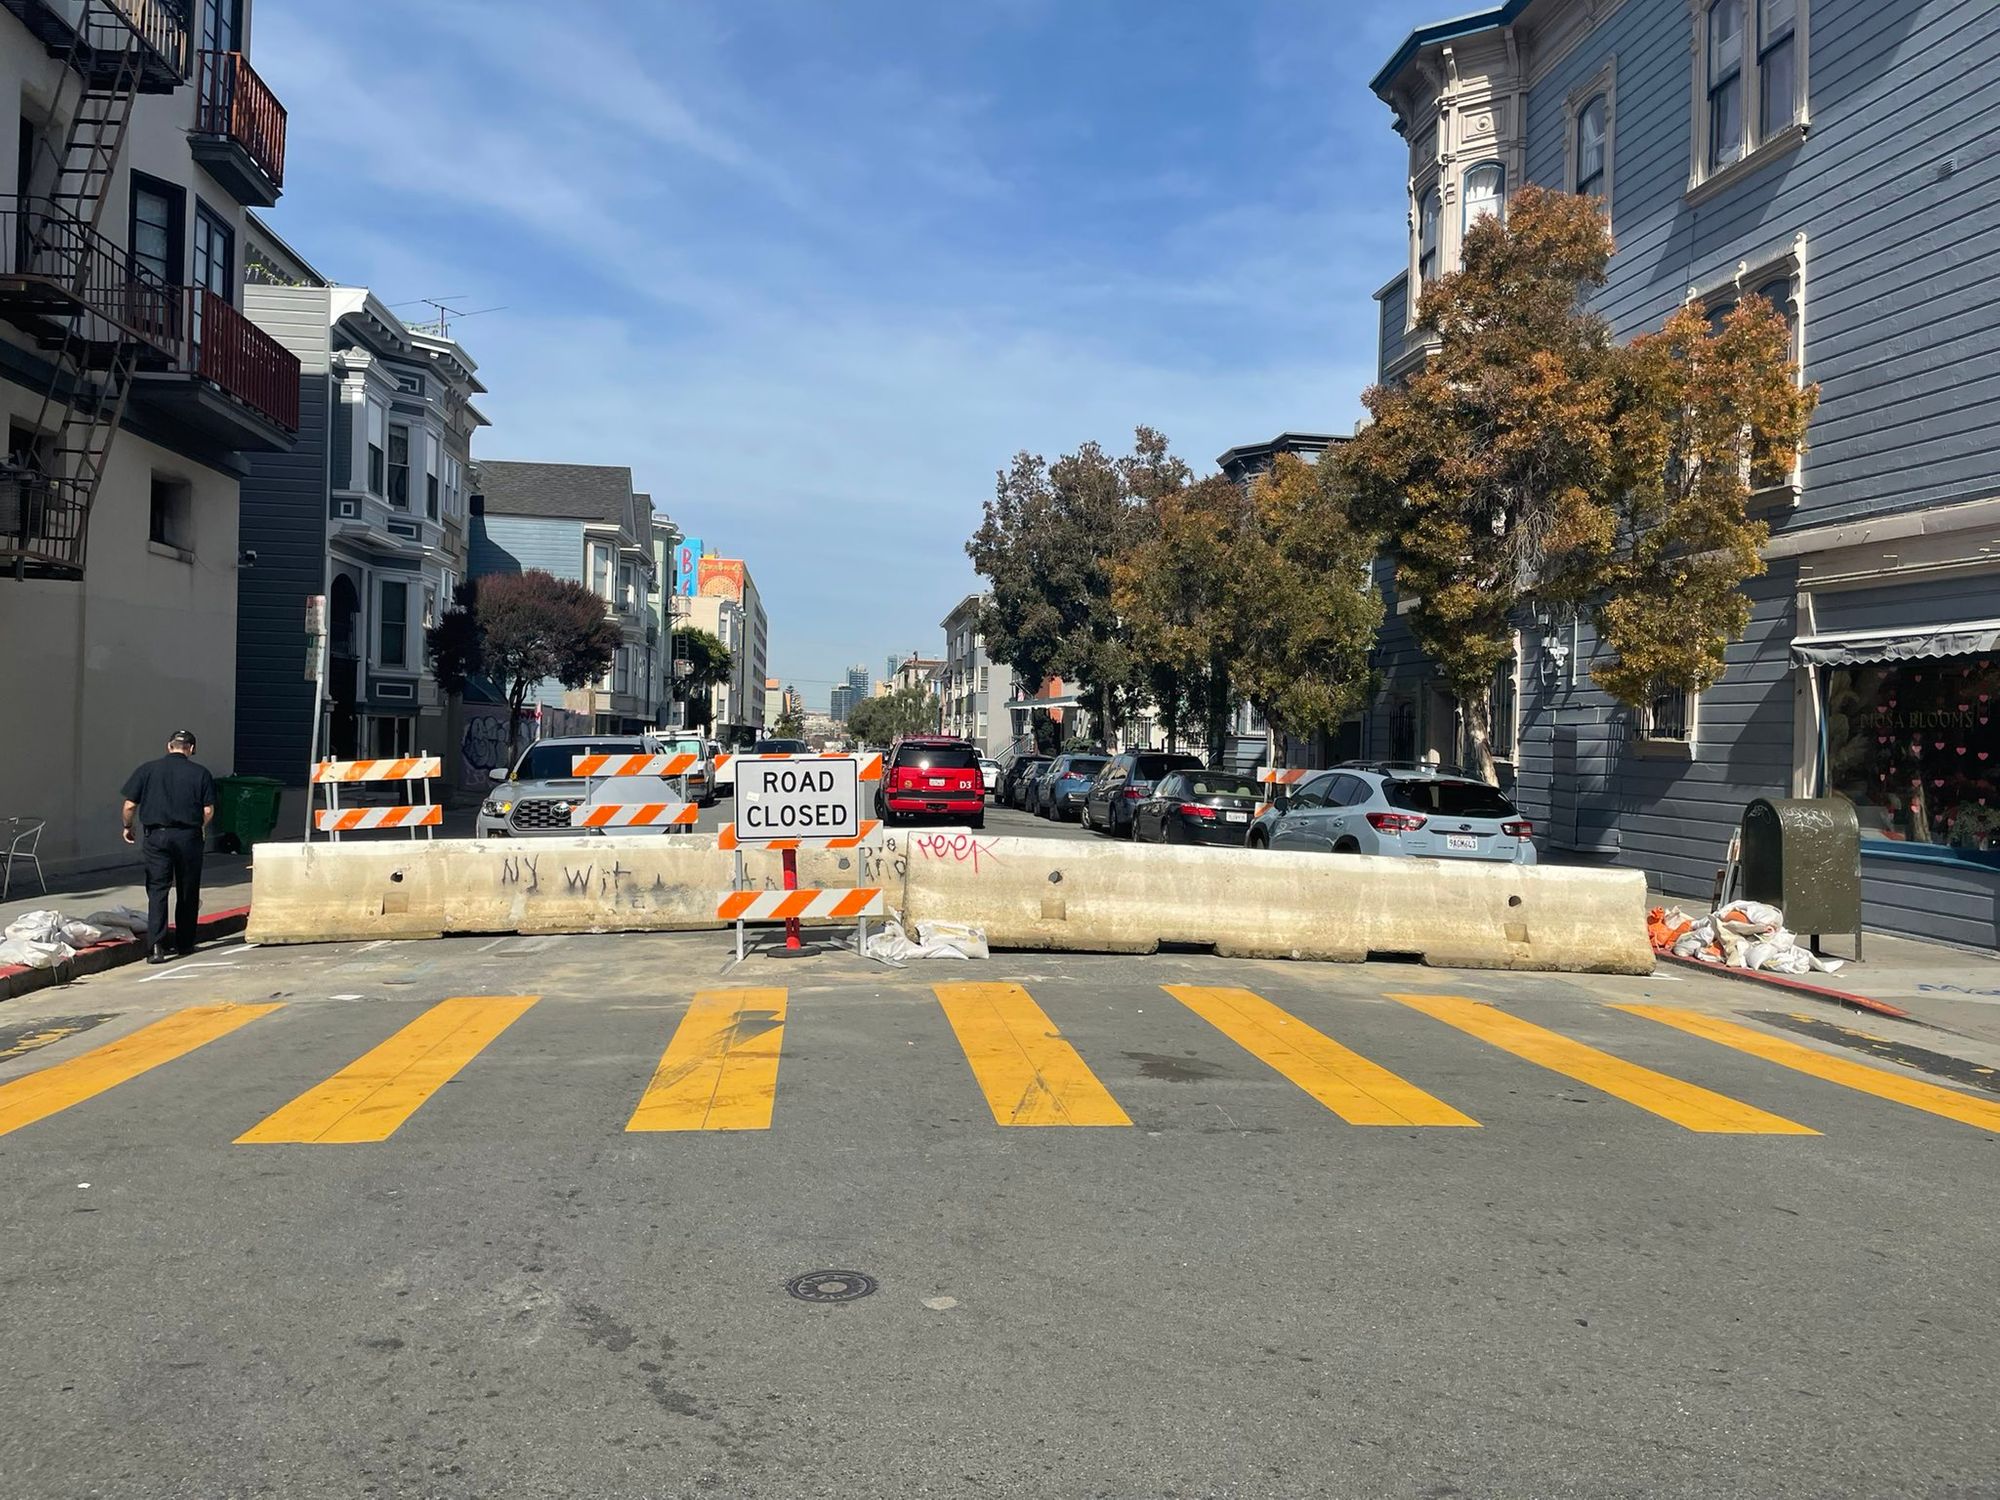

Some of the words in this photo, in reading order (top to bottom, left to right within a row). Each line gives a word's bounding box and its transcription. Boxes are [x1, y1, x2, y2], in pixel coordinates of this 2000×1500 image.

[1909, 710, 1975, 728] BLOOMS
[763, 771, 834, 793] ROAD
[959, 780, 972, 789] D3
[747, 804, 847, 828] CLOSED
